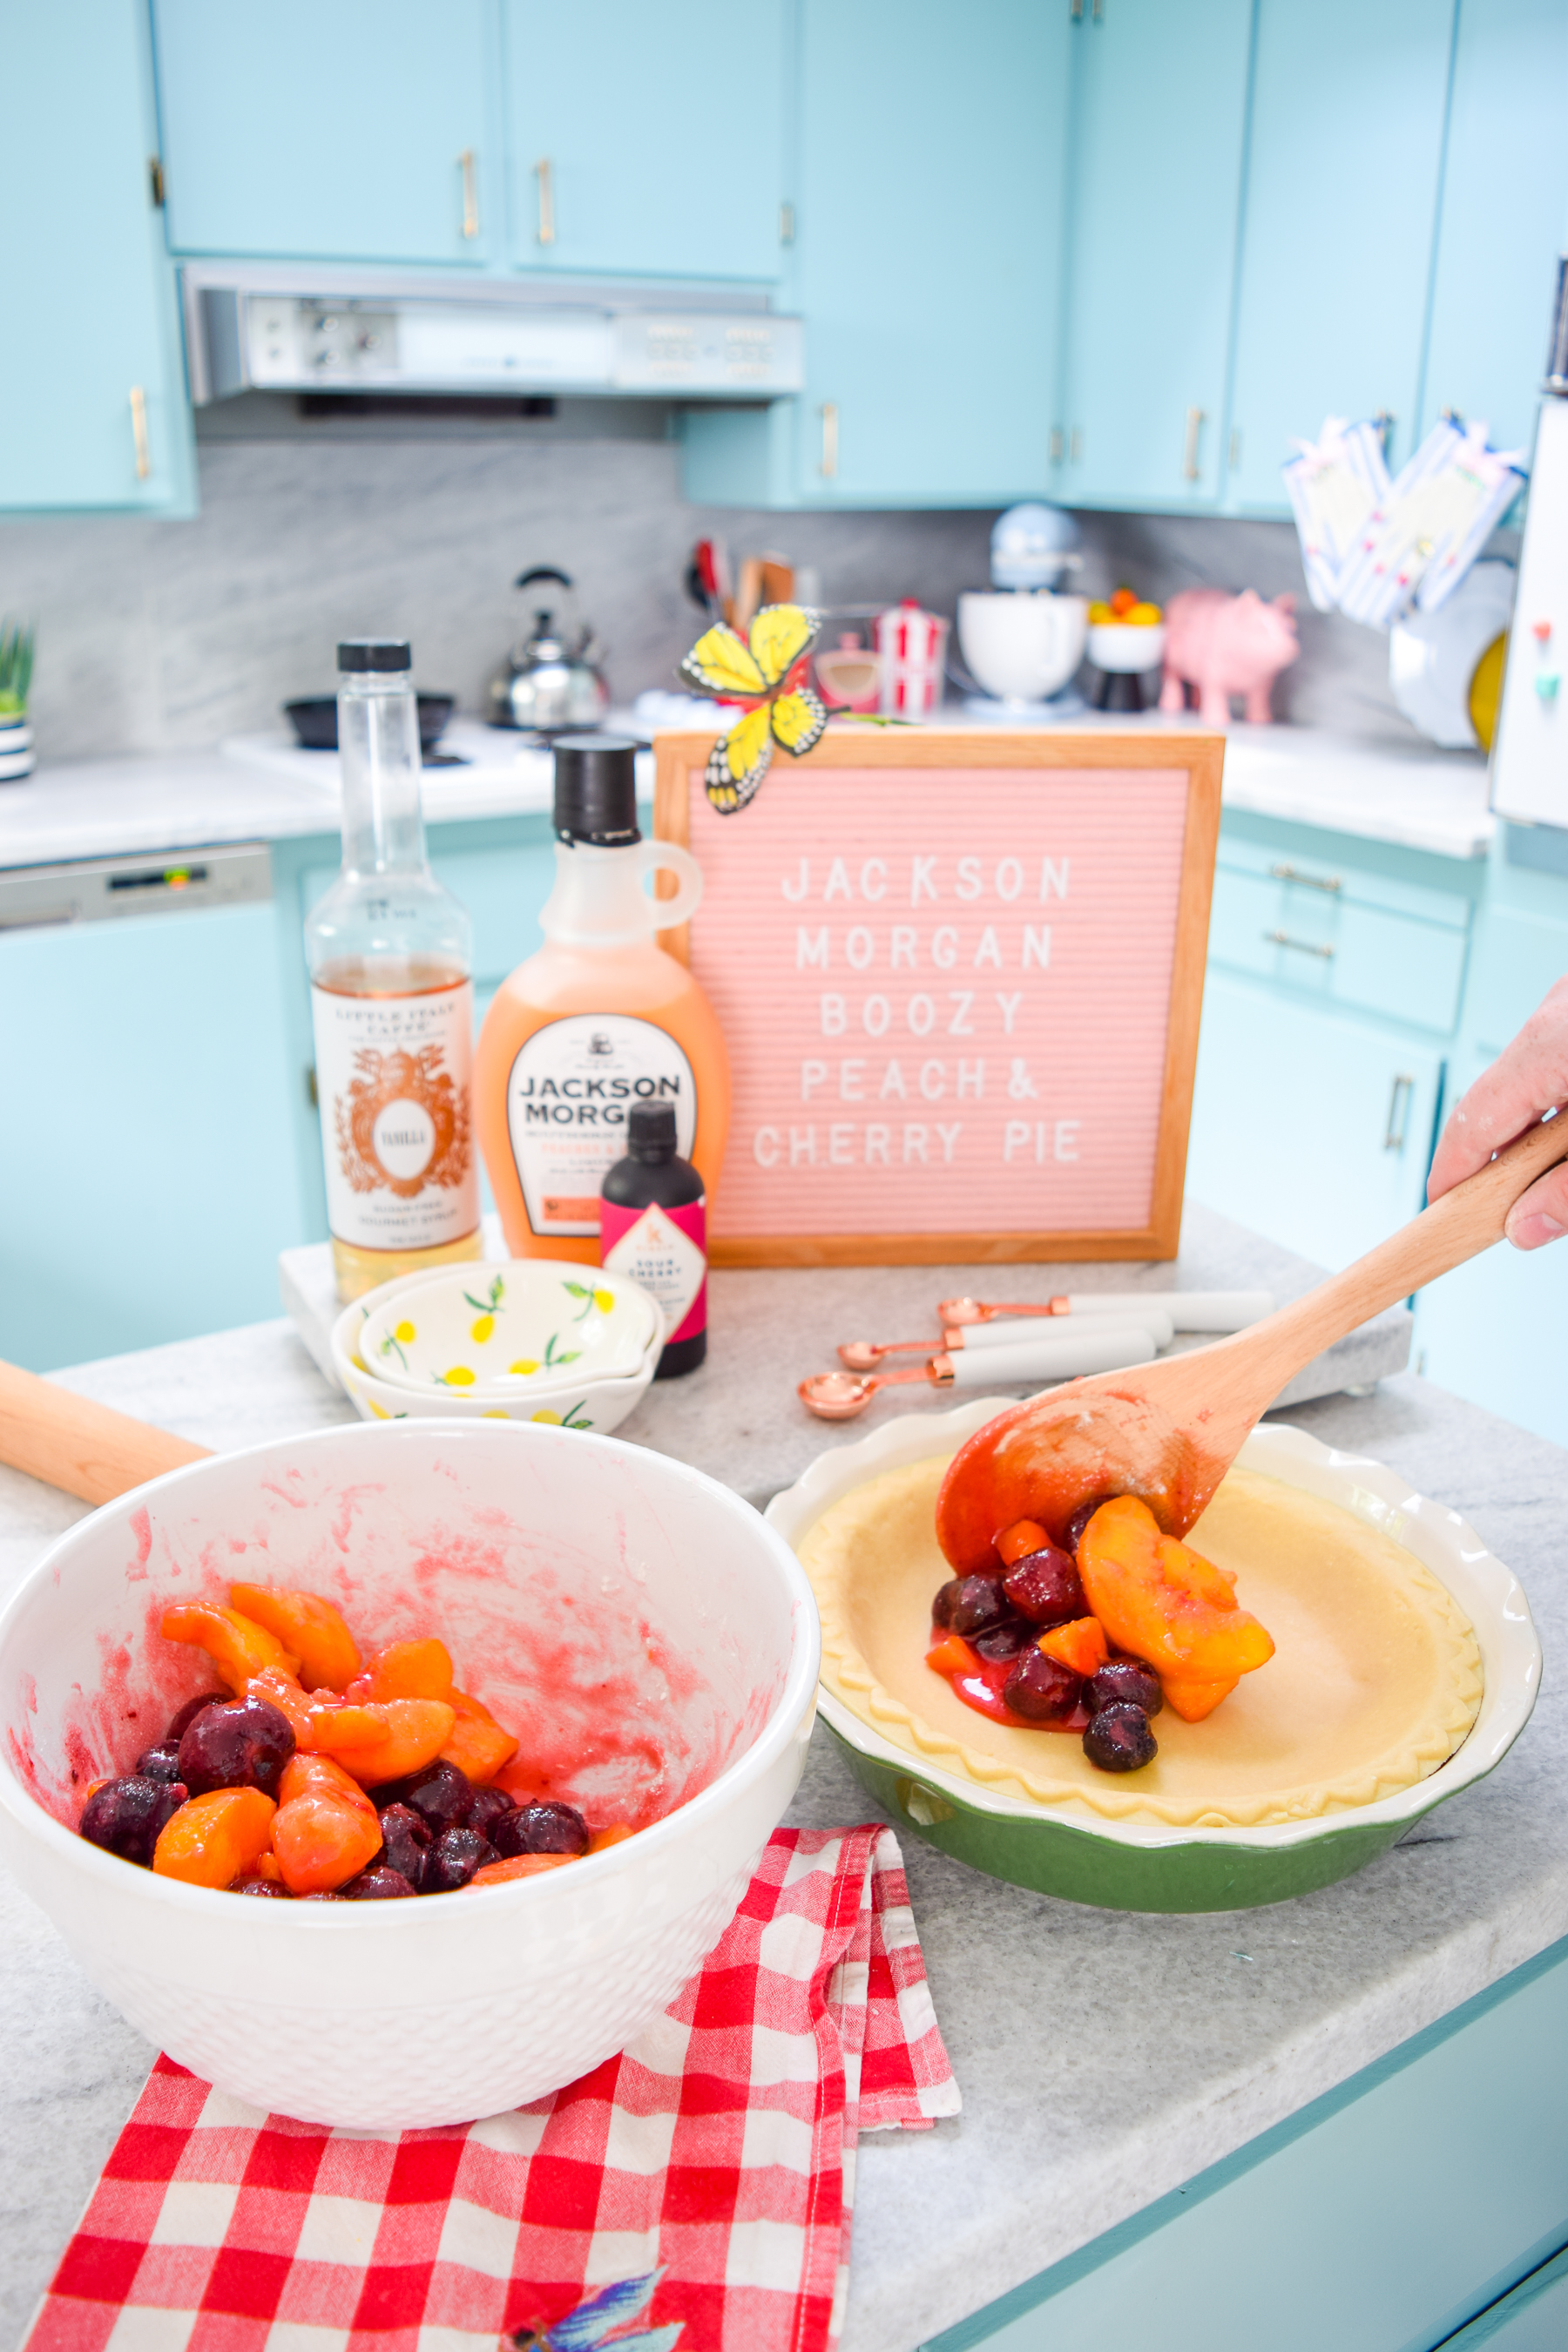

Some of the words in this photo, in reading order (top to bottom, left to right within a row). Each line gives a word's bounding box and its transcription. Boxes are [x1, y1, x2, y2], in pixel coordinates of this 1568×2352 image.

[781, 855, 1070, 908] JACKSON
[795, 923, 1053, 971] MORGAN
[820, 990, 1024, 1037] BOOZY
[520, 1075, 681, 1098] JACKSON
[801, 1058, 985, 1102] PEACH
[1006, 1058, 1039, 1100] &
[525, 1103, 626, 1125] MORG
[754, 1122, 963, 1168] CHERRY
[1003, 1119, 1082, 1164] PIE
[628, 1267, 682, 1277] CHERRY
